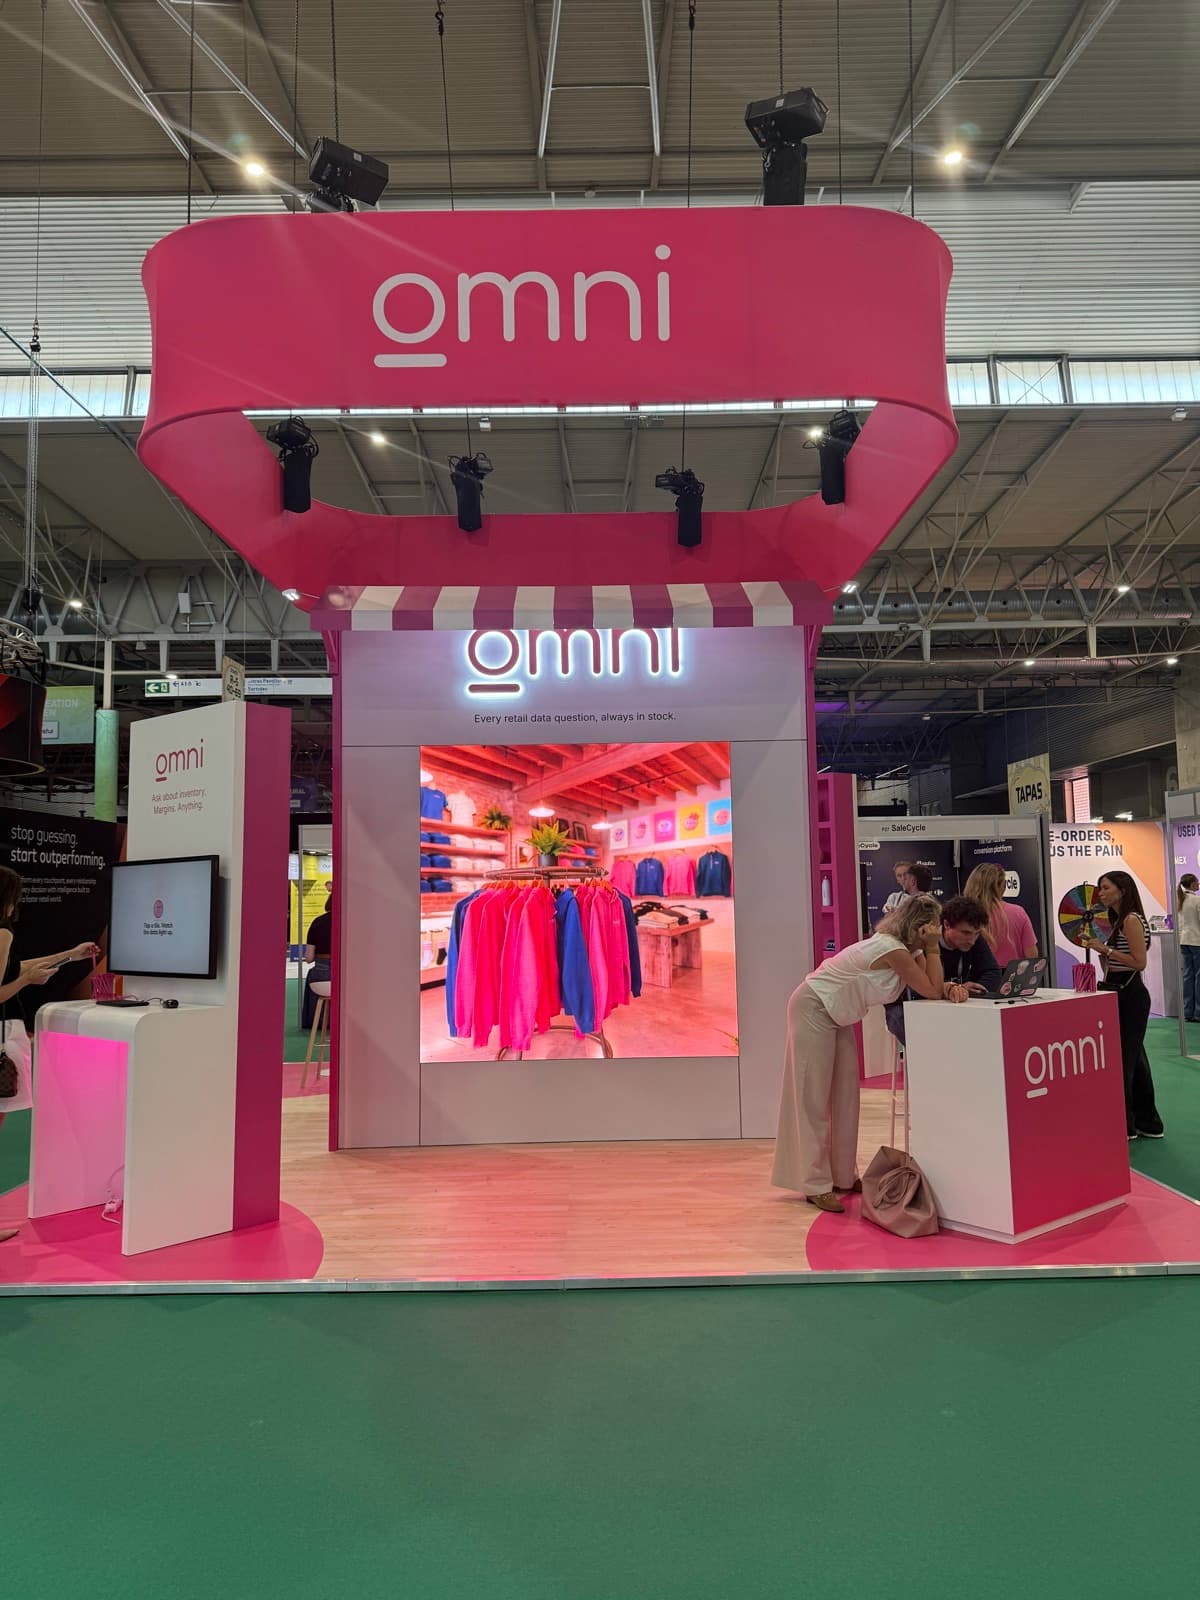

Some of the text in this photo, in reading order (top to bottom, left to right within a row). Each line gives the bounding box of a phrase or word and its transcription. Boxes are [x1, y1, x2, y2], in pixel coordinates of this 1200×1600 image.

[373, 245, 671, 368] omni
[474, 711, 676, 724] Every retail data question, always in stock.
[155, 738, 204, 782] omni
[152, 794, 162, 802] Ask
[163, 792, 178, 801] about
[1015, 781, 1042, 804] TAPAS
[10, 824, 79, 848] stop guessing.
[891, 824, 926, 833] SaleCycle
[1177, 824, 1196, 838] USED
[10, 847, 106, 870] start outperforming.
[1067, 845, 1091, 857] THE
[1095, 844, 1123, 857] PAIN
[1025, 1020, 1105, 1099] omni
